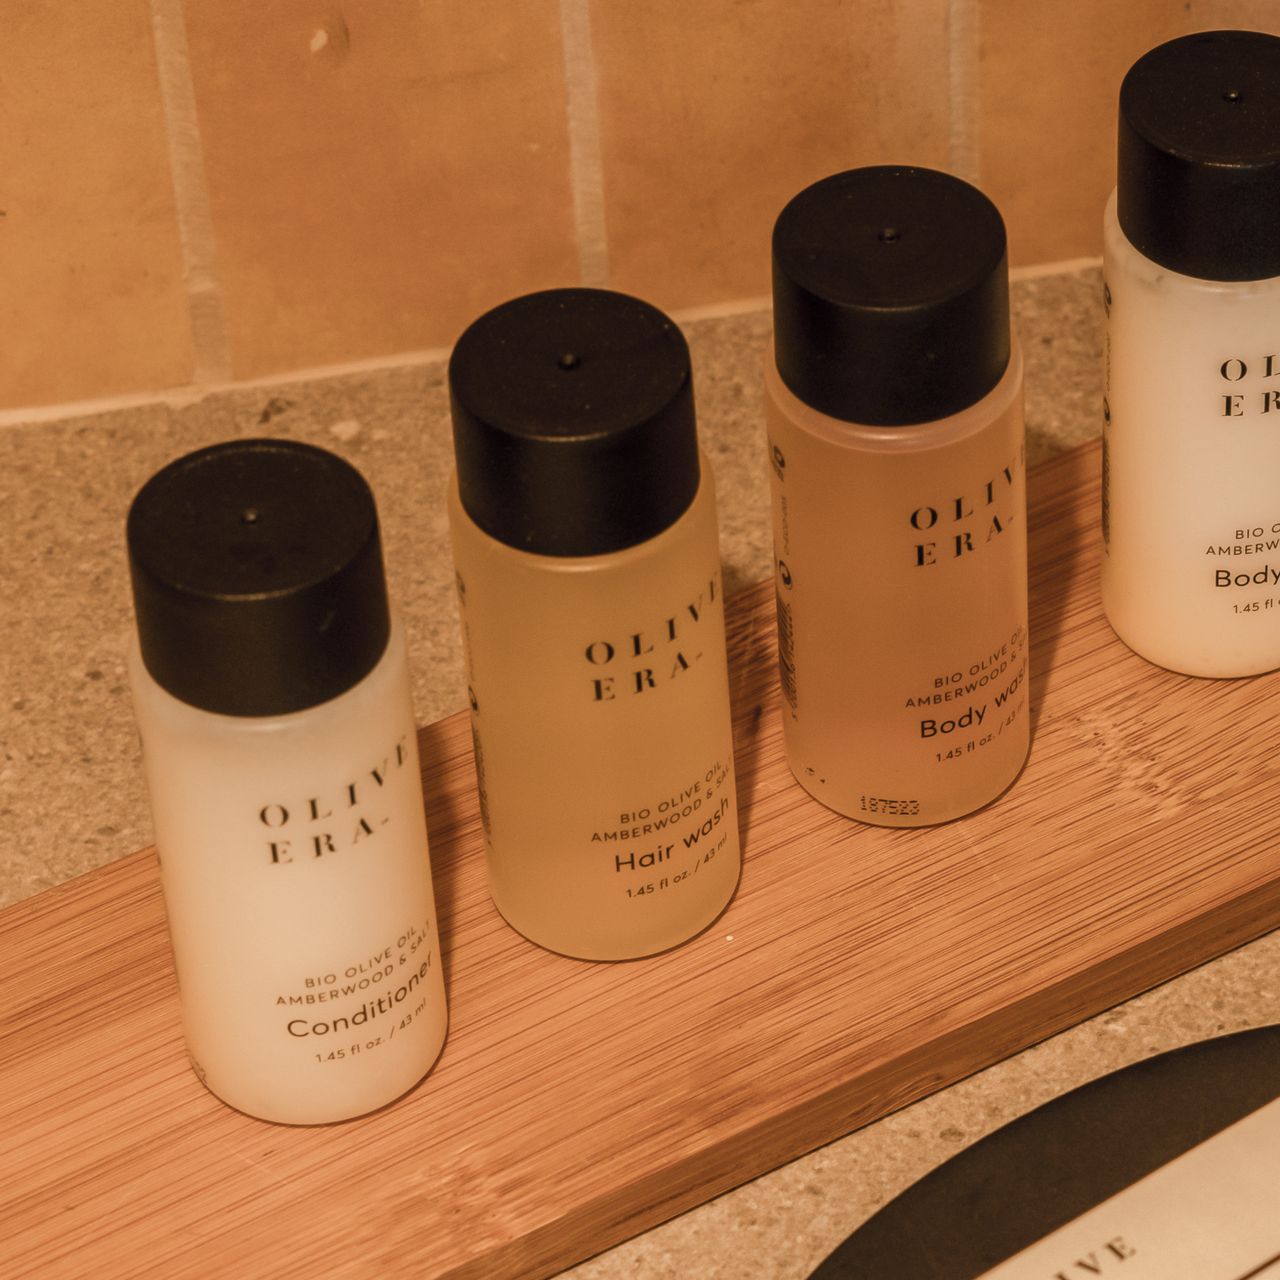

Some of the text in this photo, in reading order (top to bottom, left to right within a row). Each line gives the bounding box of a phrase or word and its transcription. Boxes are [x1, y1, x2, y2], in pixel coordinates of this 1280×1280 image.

[910, 445, 1023, 530] OLIV
[1235, 527, 1264, 540] BIO
[1233, 601, 1260, 614] 1.45
[1264, 598, 1273, 609] fl
[905, 661, 1008, 708] AMBERWOOD
[934, 672, 963, 689] BIO
[969, 643, 1007, 676] OLIVE
[920, 703, 987, 739] Body
[936, 747, 962, 762] 1.45
[967, 740, 975, 753] fl
[259, 734, 408, 828] OLIVE
[620, 761, 721, 824] BIO OLIVE OIL
[591, 798, 702, 842] AMBERWOOD
[615, 797, 729, 872] Hair wash
[626, 883, 654, 898] 1.45
[659, 878, 668, 890] fl
[694, 859, 700, 873] /
[703, 848, 715, 864] 43
[276, 964, 394, 1005] AMBERWOOD
[399, 954, 407, 966] &
[305, 926, 417, 988] BIO OLIVE OIL
[287, 951, 433, 1038] Conditioner
[315, 1049, 346, 1064] 1.45
[350, 1044, 360, 1056] fl
[365, 1037, 386, 1050] oz.
[389, 1025, 396, 1040] /
[399, 1014, 413, 1030] 43
